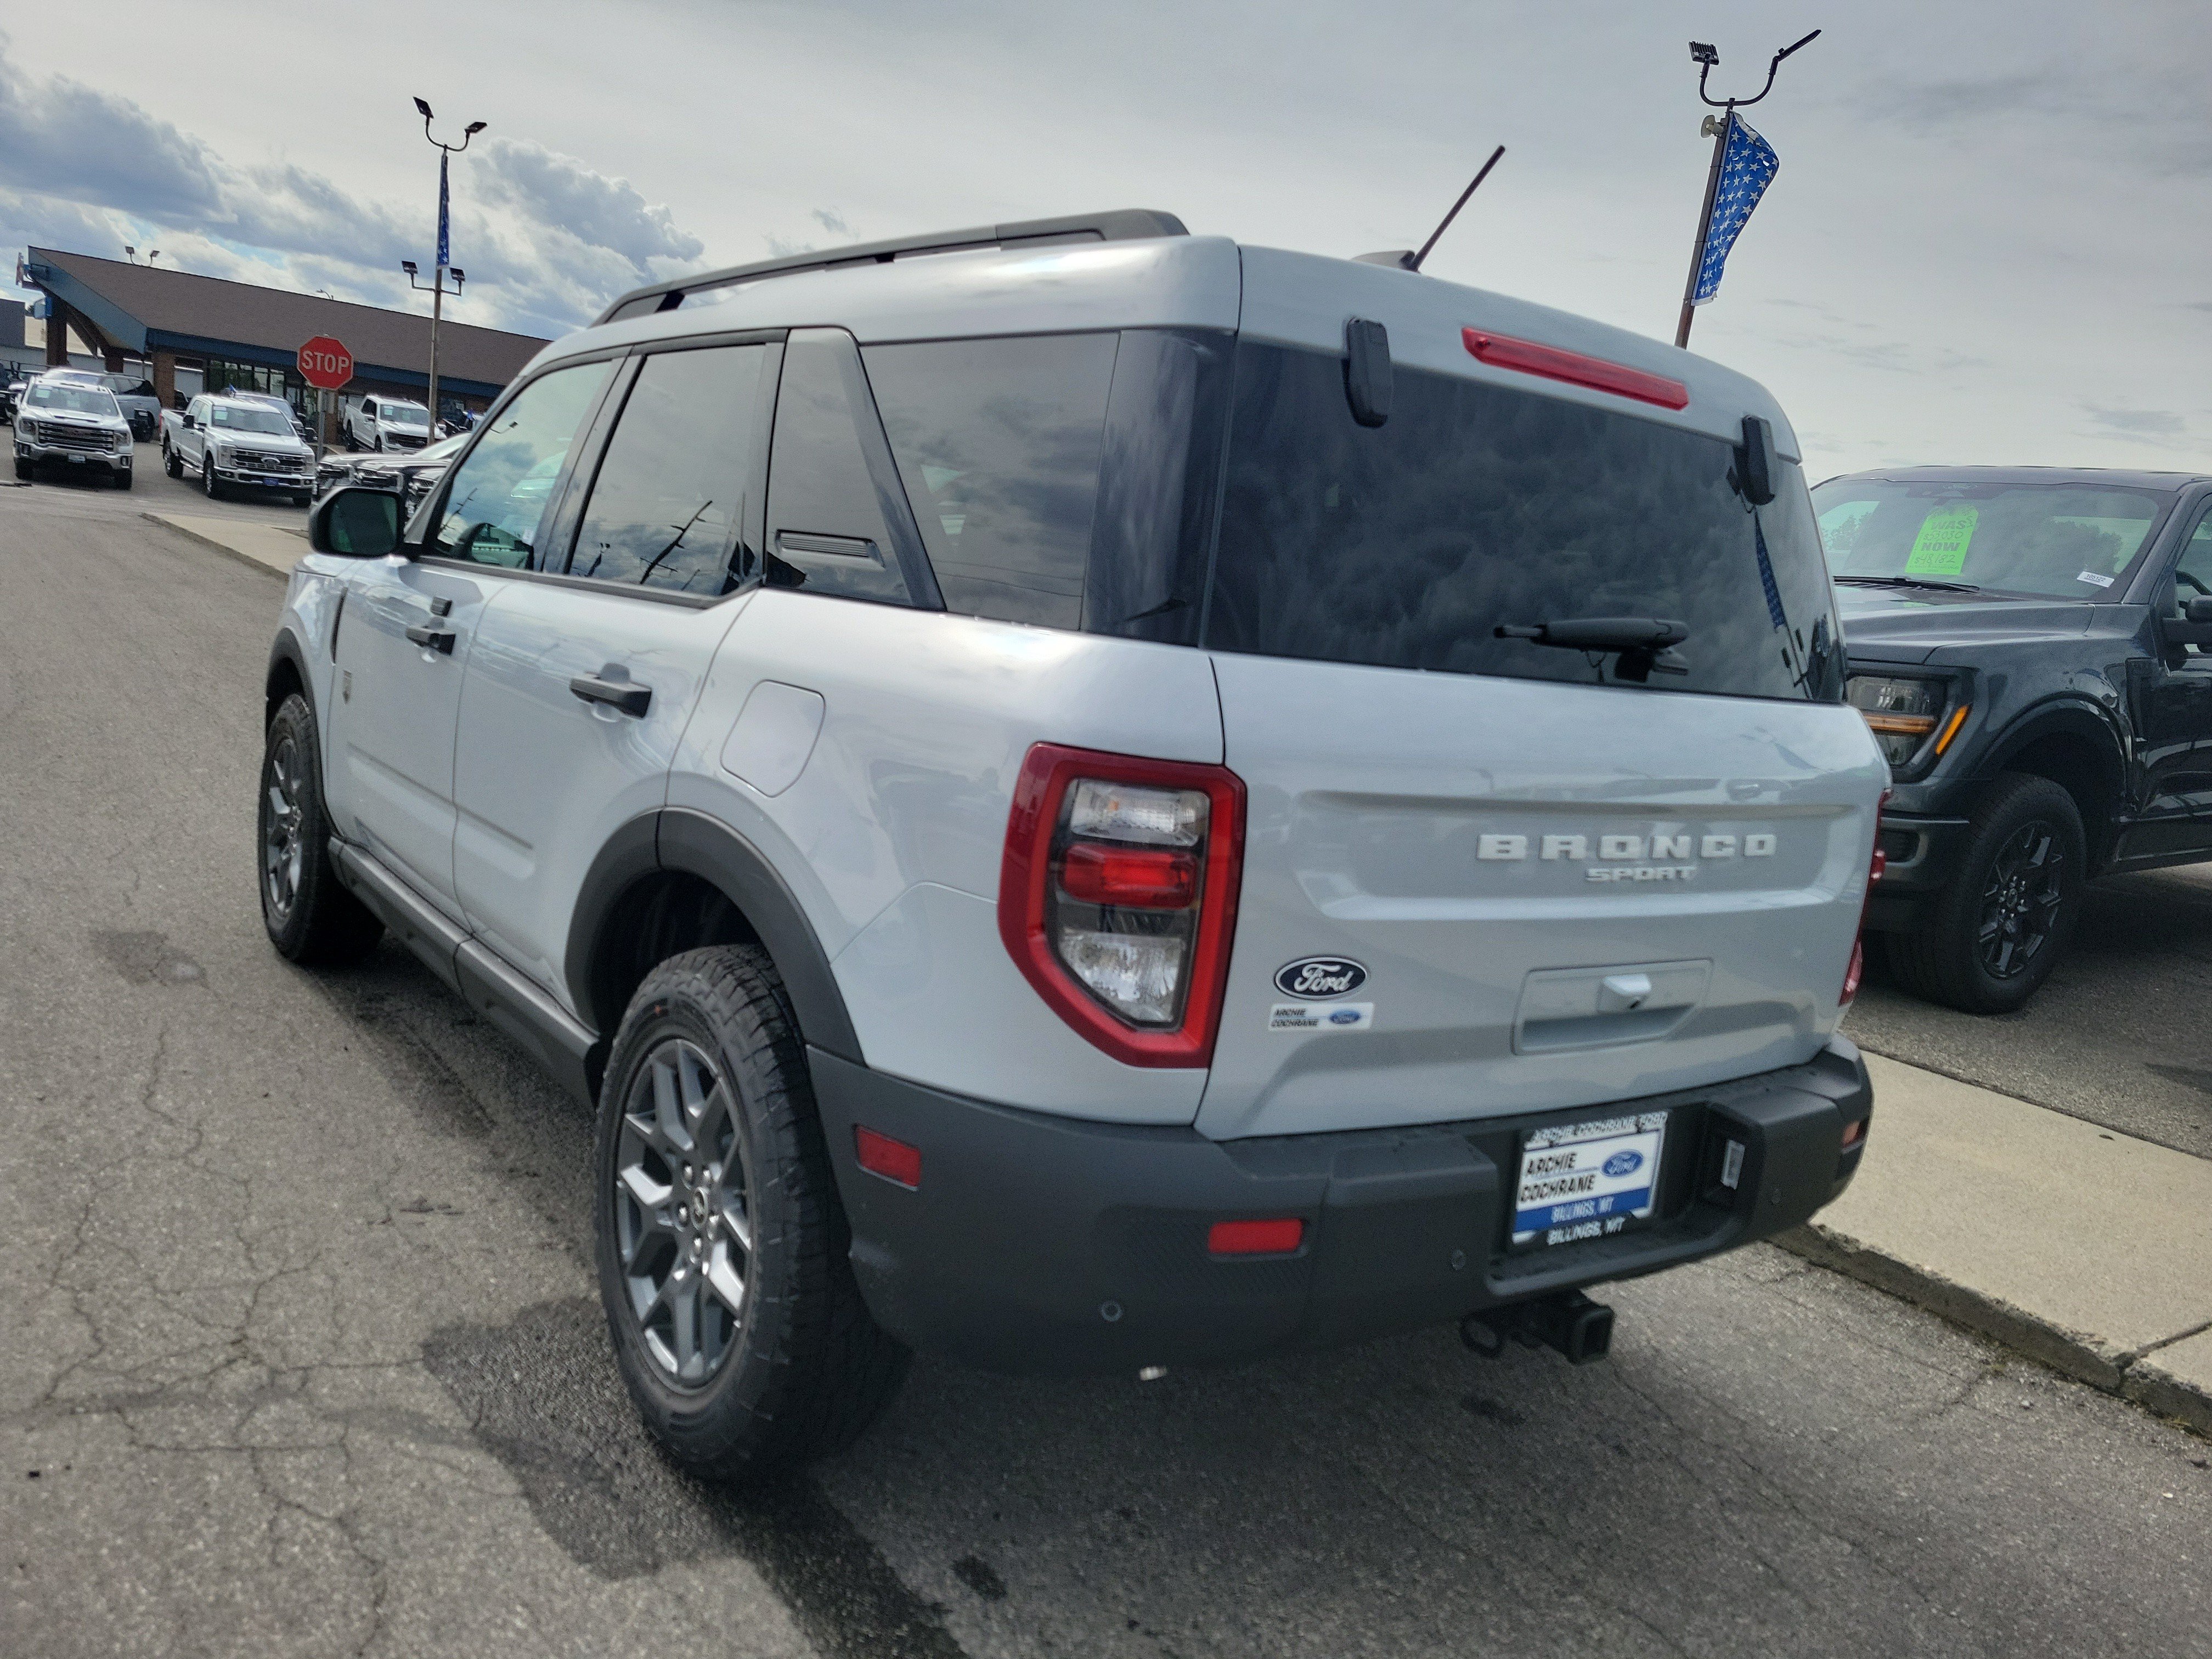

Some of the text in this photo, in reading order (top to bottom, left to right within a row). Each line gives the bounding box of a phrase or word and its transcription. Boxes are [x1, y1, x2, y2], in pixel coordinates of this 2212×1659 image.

[302, 351, 349, 374] STOP
[1931, 520, 1967, 530] WAS
[1921, 542, 1961, 551] NOW
[1477, 834, 1777, 860] BRONCO
[1587, 866, 1696, 882] SPORT
[1294, 963, 1355, 992] Ford
[1276, 1008, 1307, 1017] ARCHIE
[1271, 1018, 1319, 1028] COCHRANE
[1526, 1152, 1577, 1176] ARCHIE
[1607, 1150, 1640, 1176] Ford
[1520, 1173, 1596, 1202] COCHRANE
[1598, 1195, 1614, 1212] MT
[1605, 1216, 1626, 1234] MT
